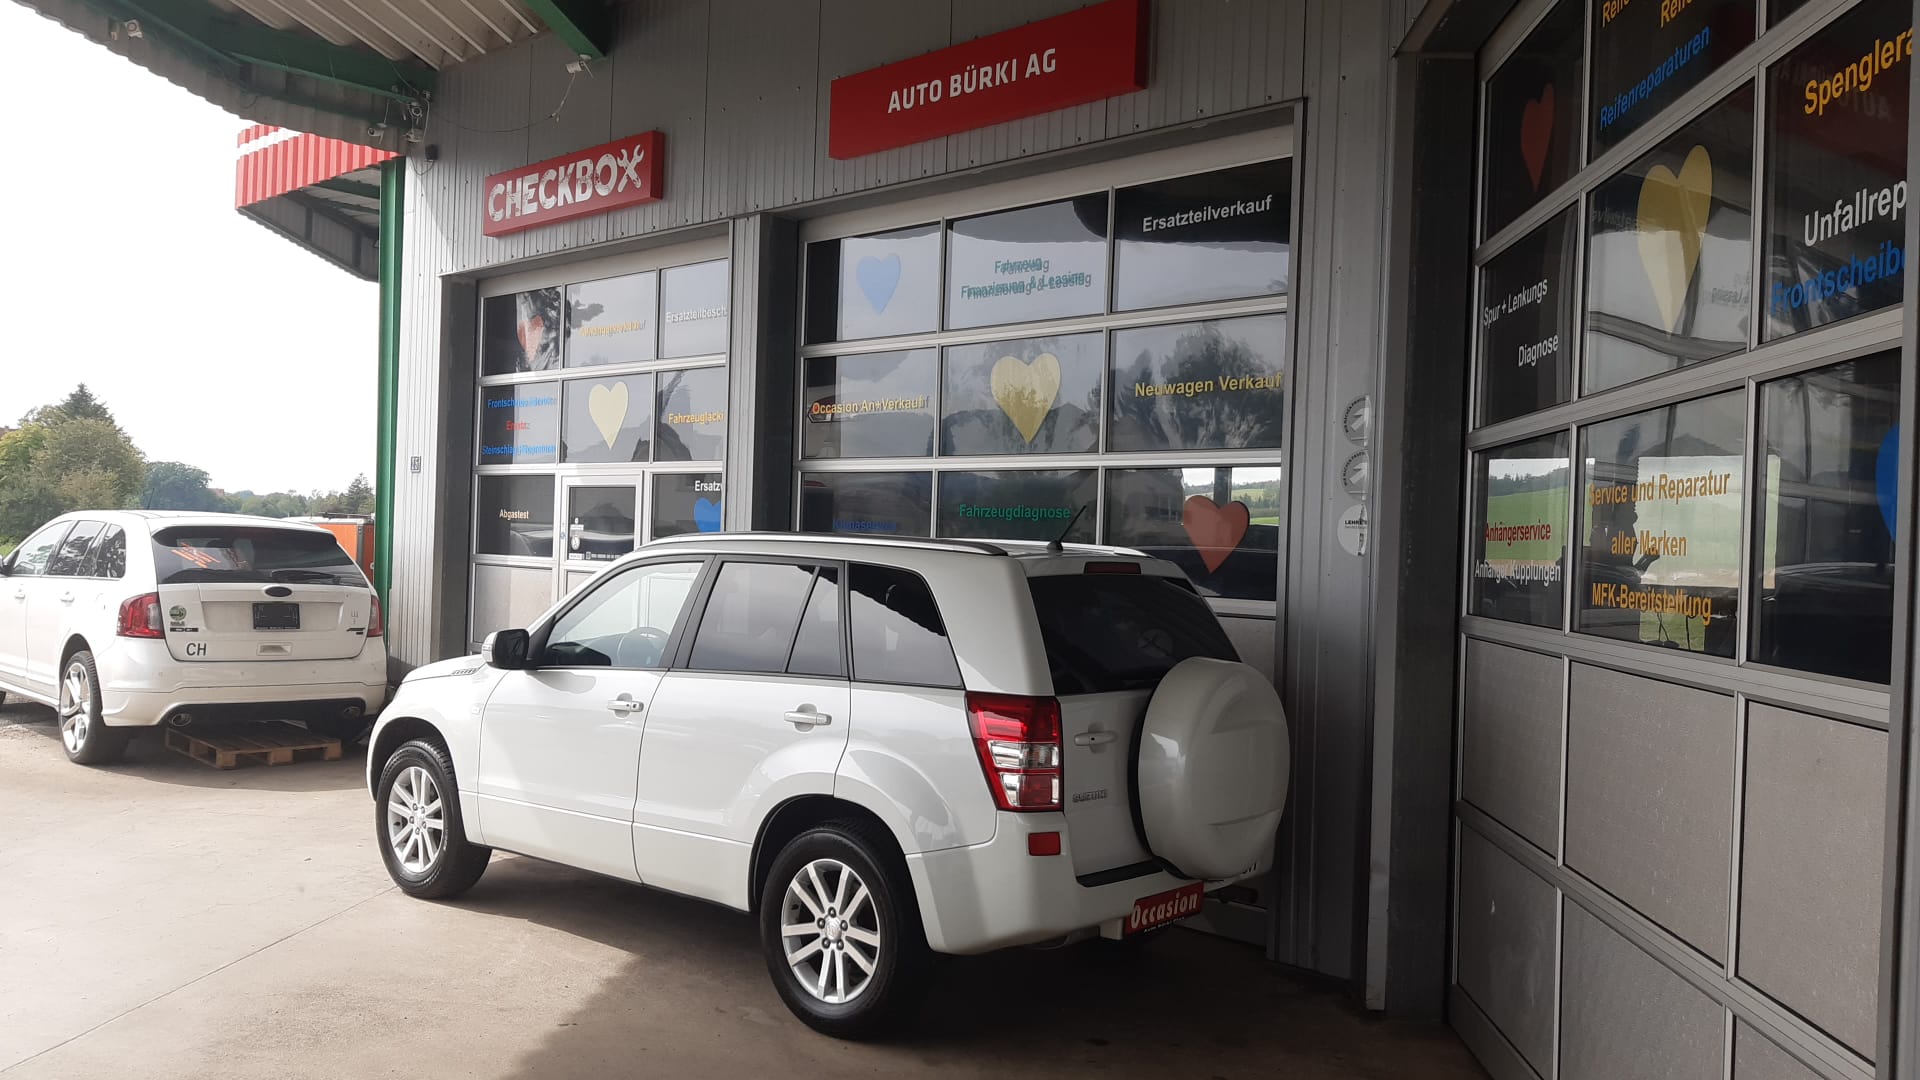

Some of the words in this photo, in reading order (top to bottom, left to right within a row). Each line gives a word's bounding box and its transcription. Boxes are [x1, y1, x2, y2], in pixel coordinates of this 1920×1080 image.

[888, 80, 942, 113] AUTO
[950, 59, 1017, 98] BÜRKI
[1025, 48, 1057, 79] AG
[1600, 25, 1711, 130] Reifenreparaturen
[488, 144, 645, 222] CHECKBOX
[1143, 194, 1273, 233] Ersatzteilverkauf
[1804, 180, 1908, 247] Unfallrep
[1770, 240, 1906, 316] Frontscheib
[1483, 302, 1500, 328] Spur
[1507, 278, 1548, 315] Lenkungs
[1518, 332, 1559, 368] Diagnose
[1135, 379, 1214, 398] Neuwagen
[1219, 373, 1284, 391] Verkauf
[812, 402, 859, 414] Occasion
[695, 480, 723, 492] Ersatz
[1589, 480, 1628, 507] Service
[1632, 476, 1654, 502] und
[1659, 469, 1731, 505] Reparatur
[499, 508, 529, 521] Abgastest
[959, 503, 1071, 521] Fahrzeugdiagnose
[1485, 518, 1551, 547] Anhängerservice
[1610, 533, 1636, 557] aller
[1640, 530, 1687, 557] Marken
[1510, 560, 1561, 587] Kupplungen
[1592, 581, 1712, 627] MFK-Bereitstellung
[186, 642, 207, 657] CH
[1131, 892, 1198, 929] Occasion
